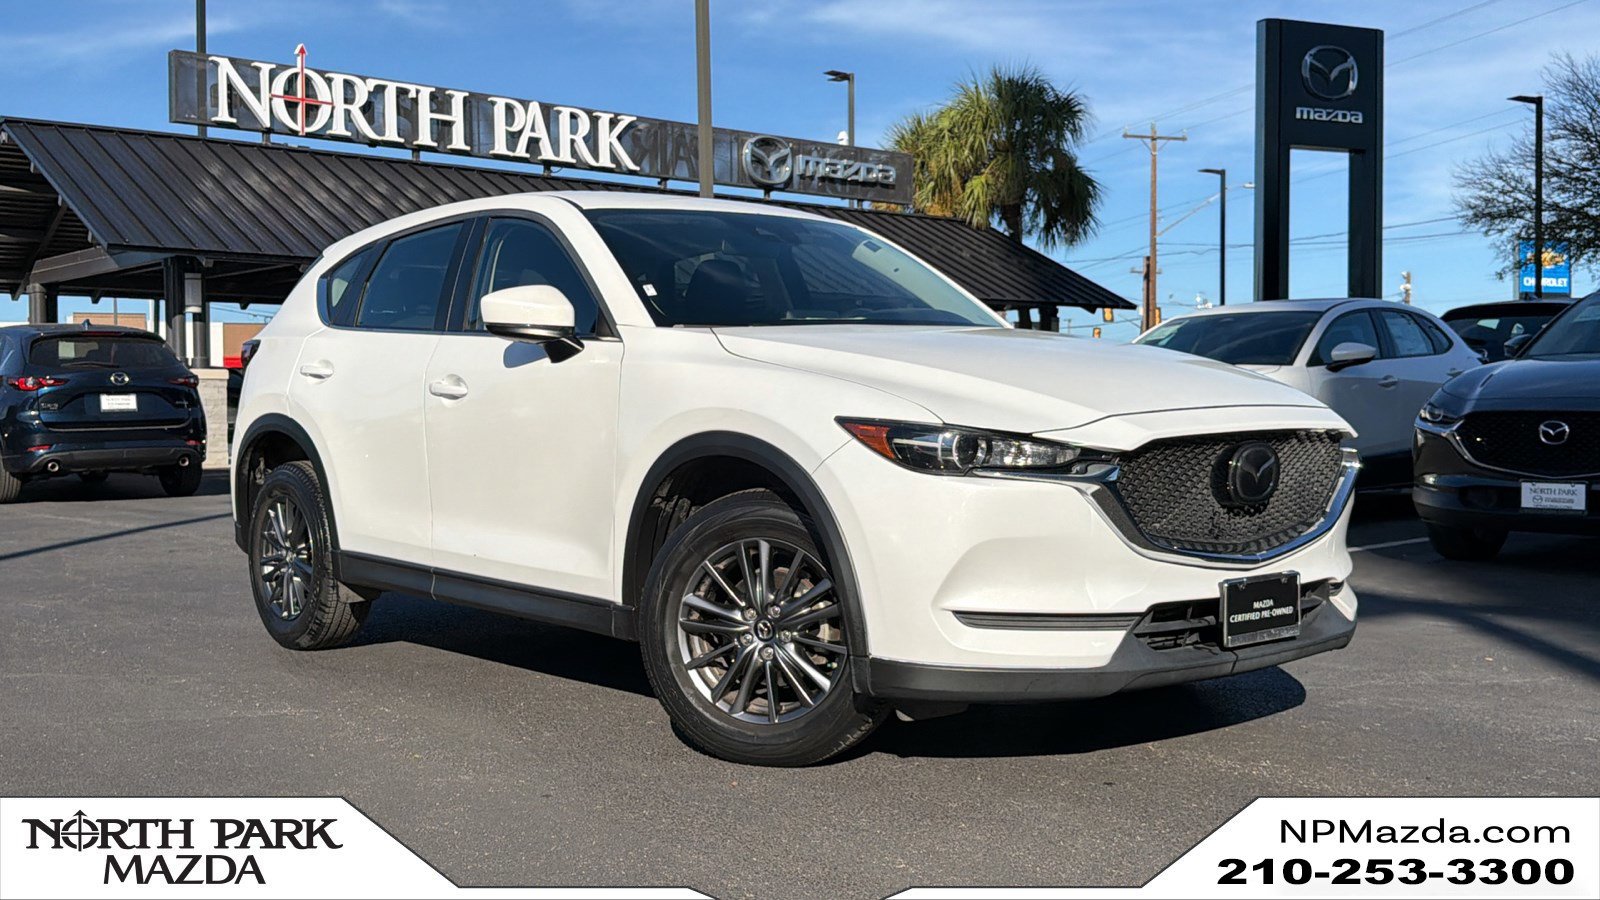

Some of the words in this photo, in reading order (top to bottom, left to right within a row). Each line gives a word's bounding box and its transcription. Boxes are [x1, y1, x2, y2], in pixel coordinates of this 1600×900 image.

[208, 54, 470, 151] NORTH
[488, 96, 640, 171] PARK
[1295, 106, 1363, 124] mazda
[796, 154, 896, 185] mazda
[1253, 599, 1274, 609] MAZDA
[1229, 611, 1261, 623] CERTIFIED
[1261, 606, 1294, 618] PRE-OWNED
